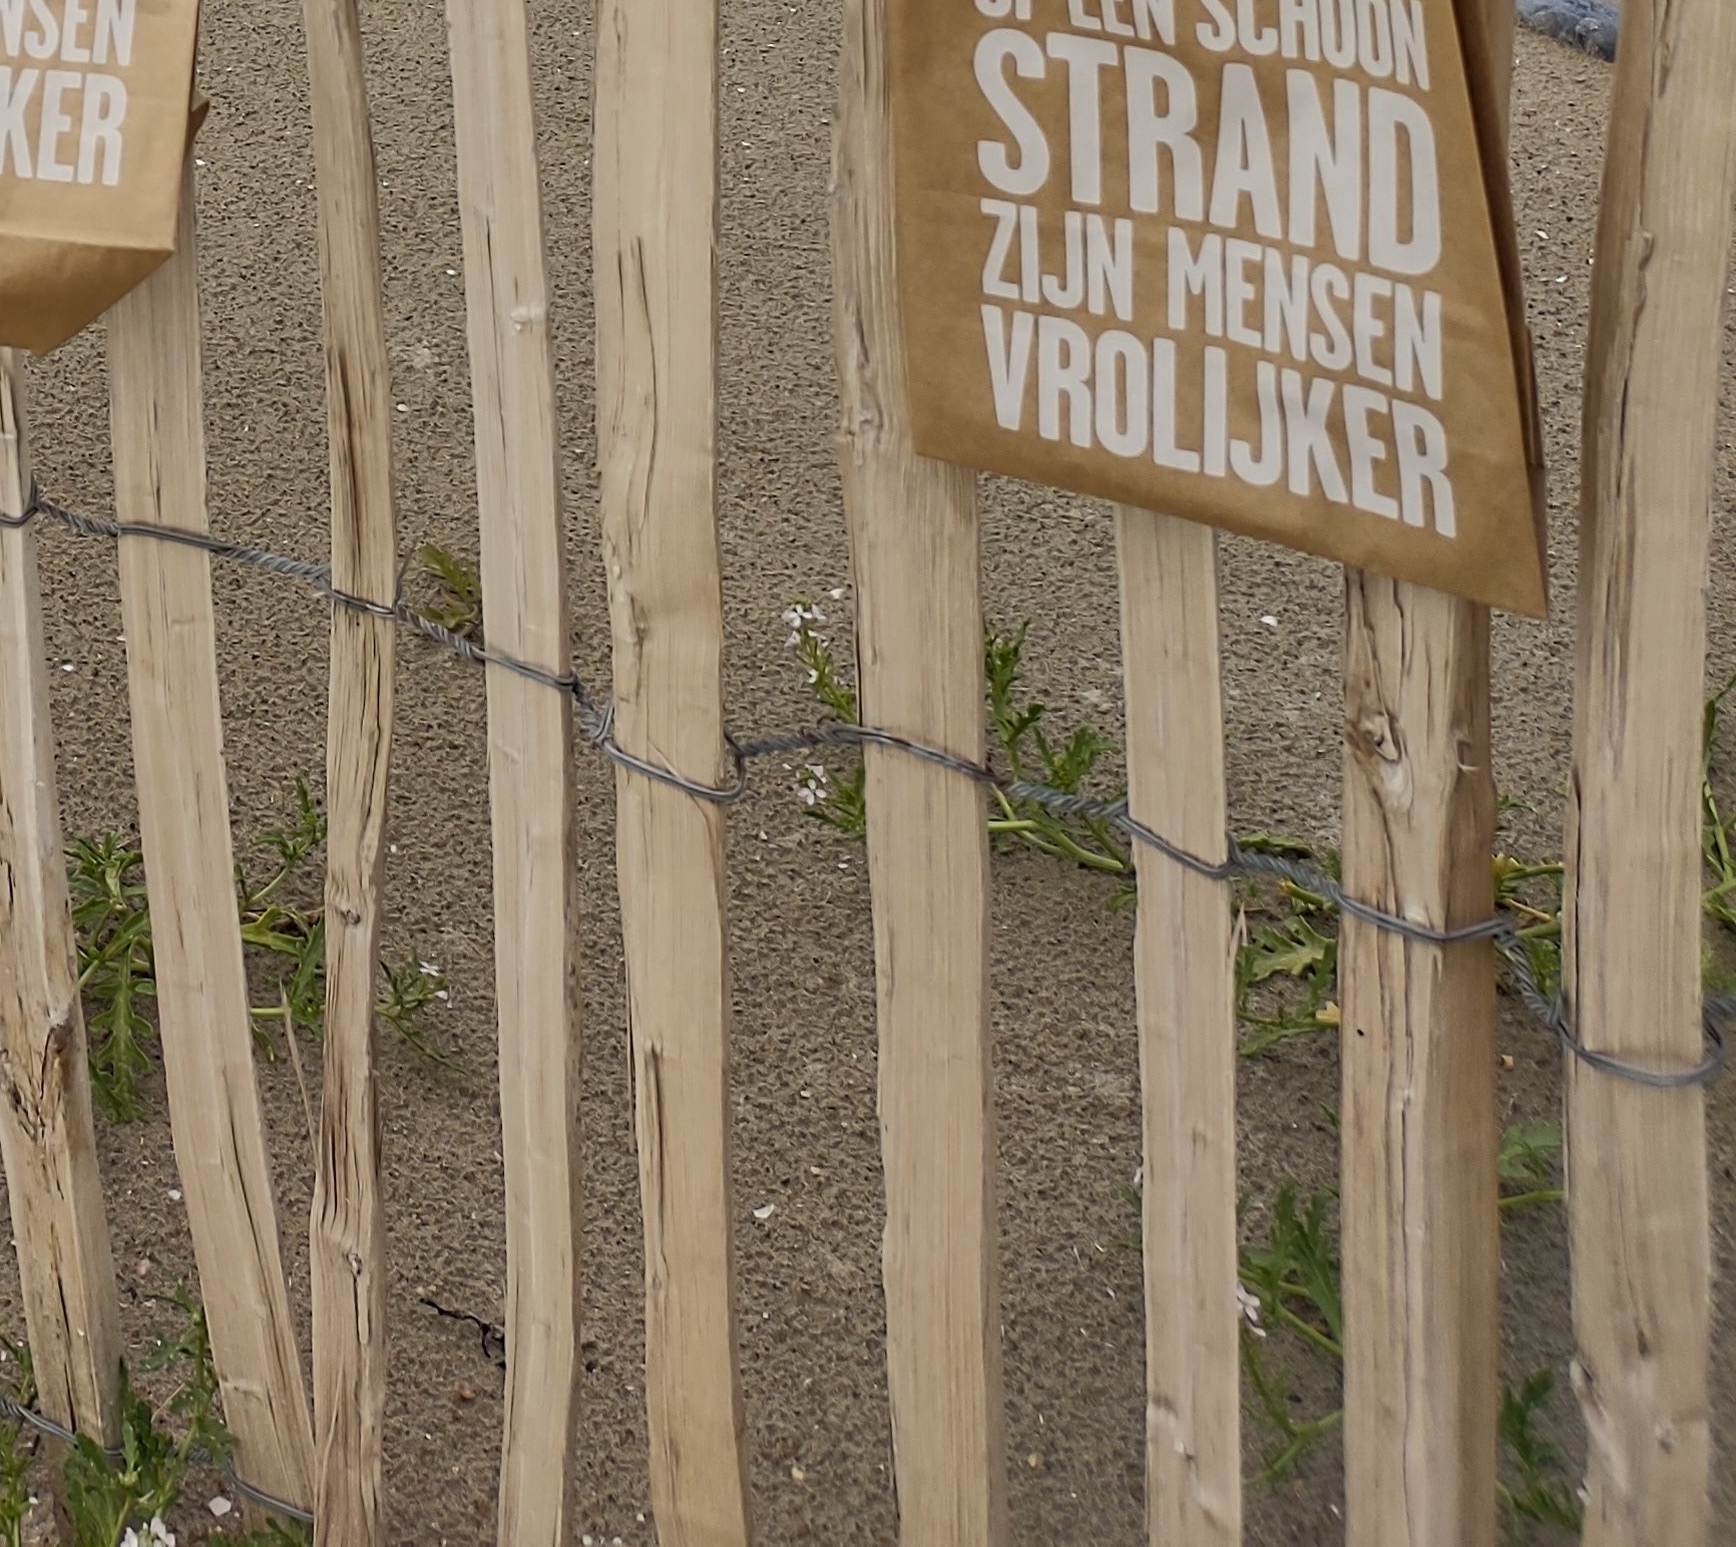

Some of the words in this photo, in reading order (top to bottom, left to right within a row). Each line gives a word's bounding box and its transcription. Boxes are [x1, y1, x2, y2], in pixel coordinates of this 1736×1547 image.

[973, 28, 1442, 276] STRAND
[980, 199, 1134, 316] ZIJN
[1168, 227, 1444, 399] MENSEN
[980, 305, 1457, 538] VROLIJKER
